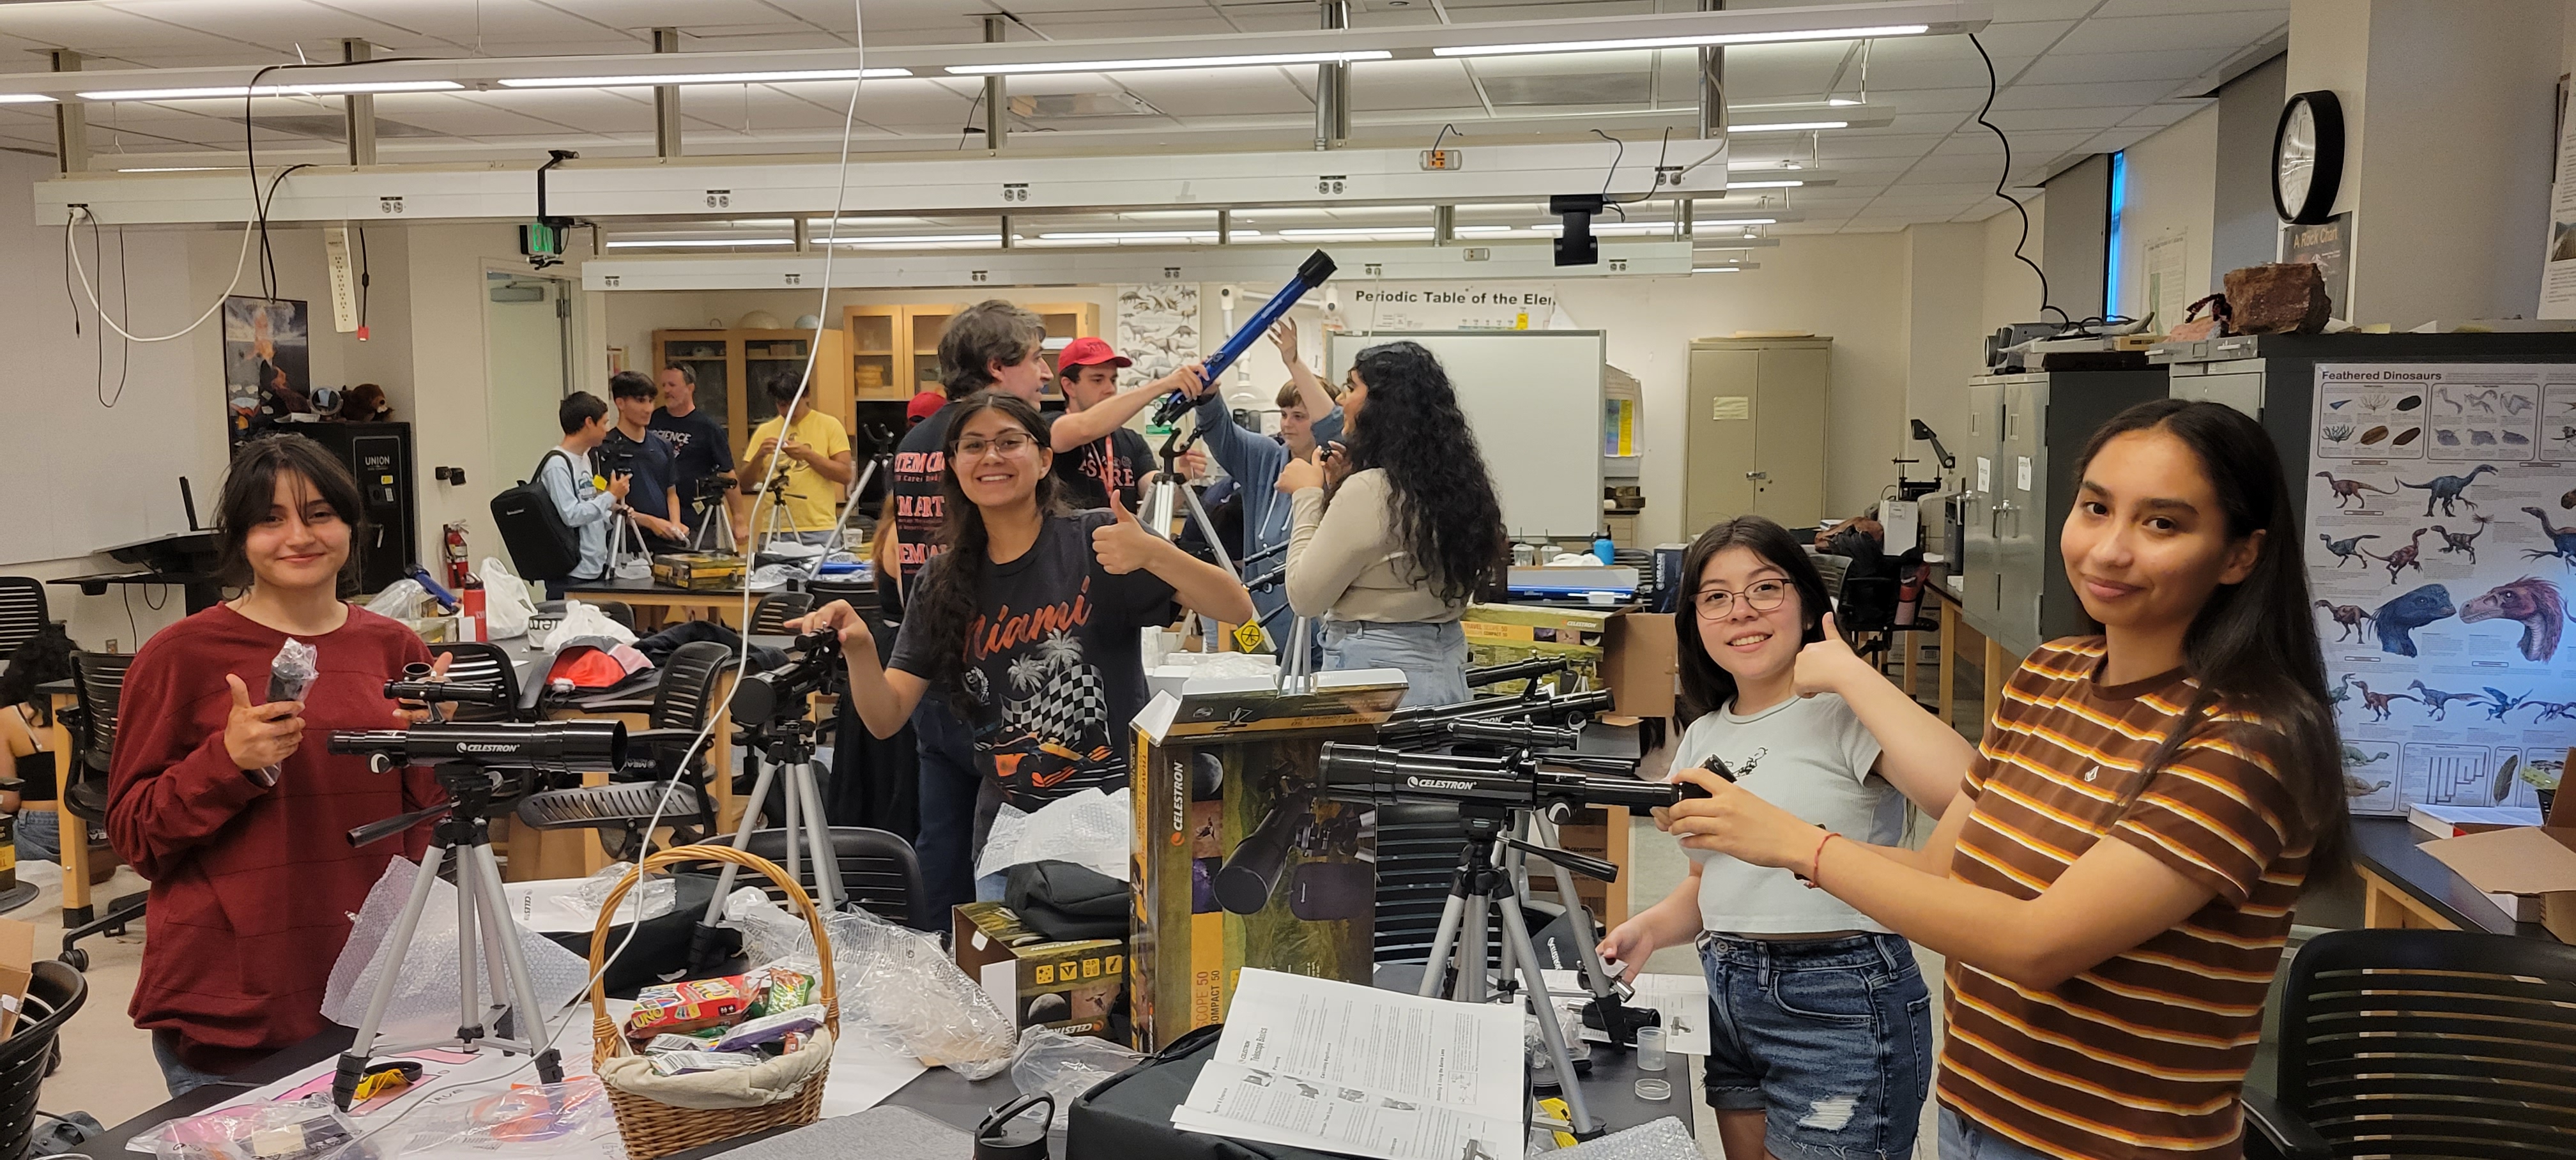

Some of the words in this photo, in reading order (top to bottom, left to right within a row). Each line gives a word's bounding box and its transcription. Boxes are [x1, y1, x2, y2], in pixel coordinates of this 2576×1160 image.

[2294, 234, 2300, 249] A
[2301, 231, 2319, 248] Rock
[1356, 290, 1418, 303] Periodic
[1423, 291, 1466, 304] Table
[1471, 293, 1487, 305] of
[1492, 293, 1518, 305] the
[1523, 293, 1556, 306] Ele
[2322, 370, 2380, 381] Feathered
[2383, 370, 2442, 381] Dinosaurs
[365, 455, 390, 466] UNION
[894, 452, 928, 473] TEM
[1078, 458, 1135, 487] ASRE
[896, 495, 913, 517] M
[916, 495, 945, 517] ART
[1567, 620, 1597, 629] CELESTRON
[467, 744, 518, 753] CELESTRON
[1418, 777, 1473, 791] CELESTRON
[1173, 762, 1184, 831] CELESTRON
[1196, 971, 1209, 986] 50
[1211, 970, 1220, 981] 50
[631, 1007, 665, 1029] UNO
[1195, 991, 1209, 1028] SCOPE
[1255, 1027, 1268, 1042] Basics
[1241, 1040, 1250, 1059] CELESTRON
[1250, 1042, 1265, 1062] Telescope
